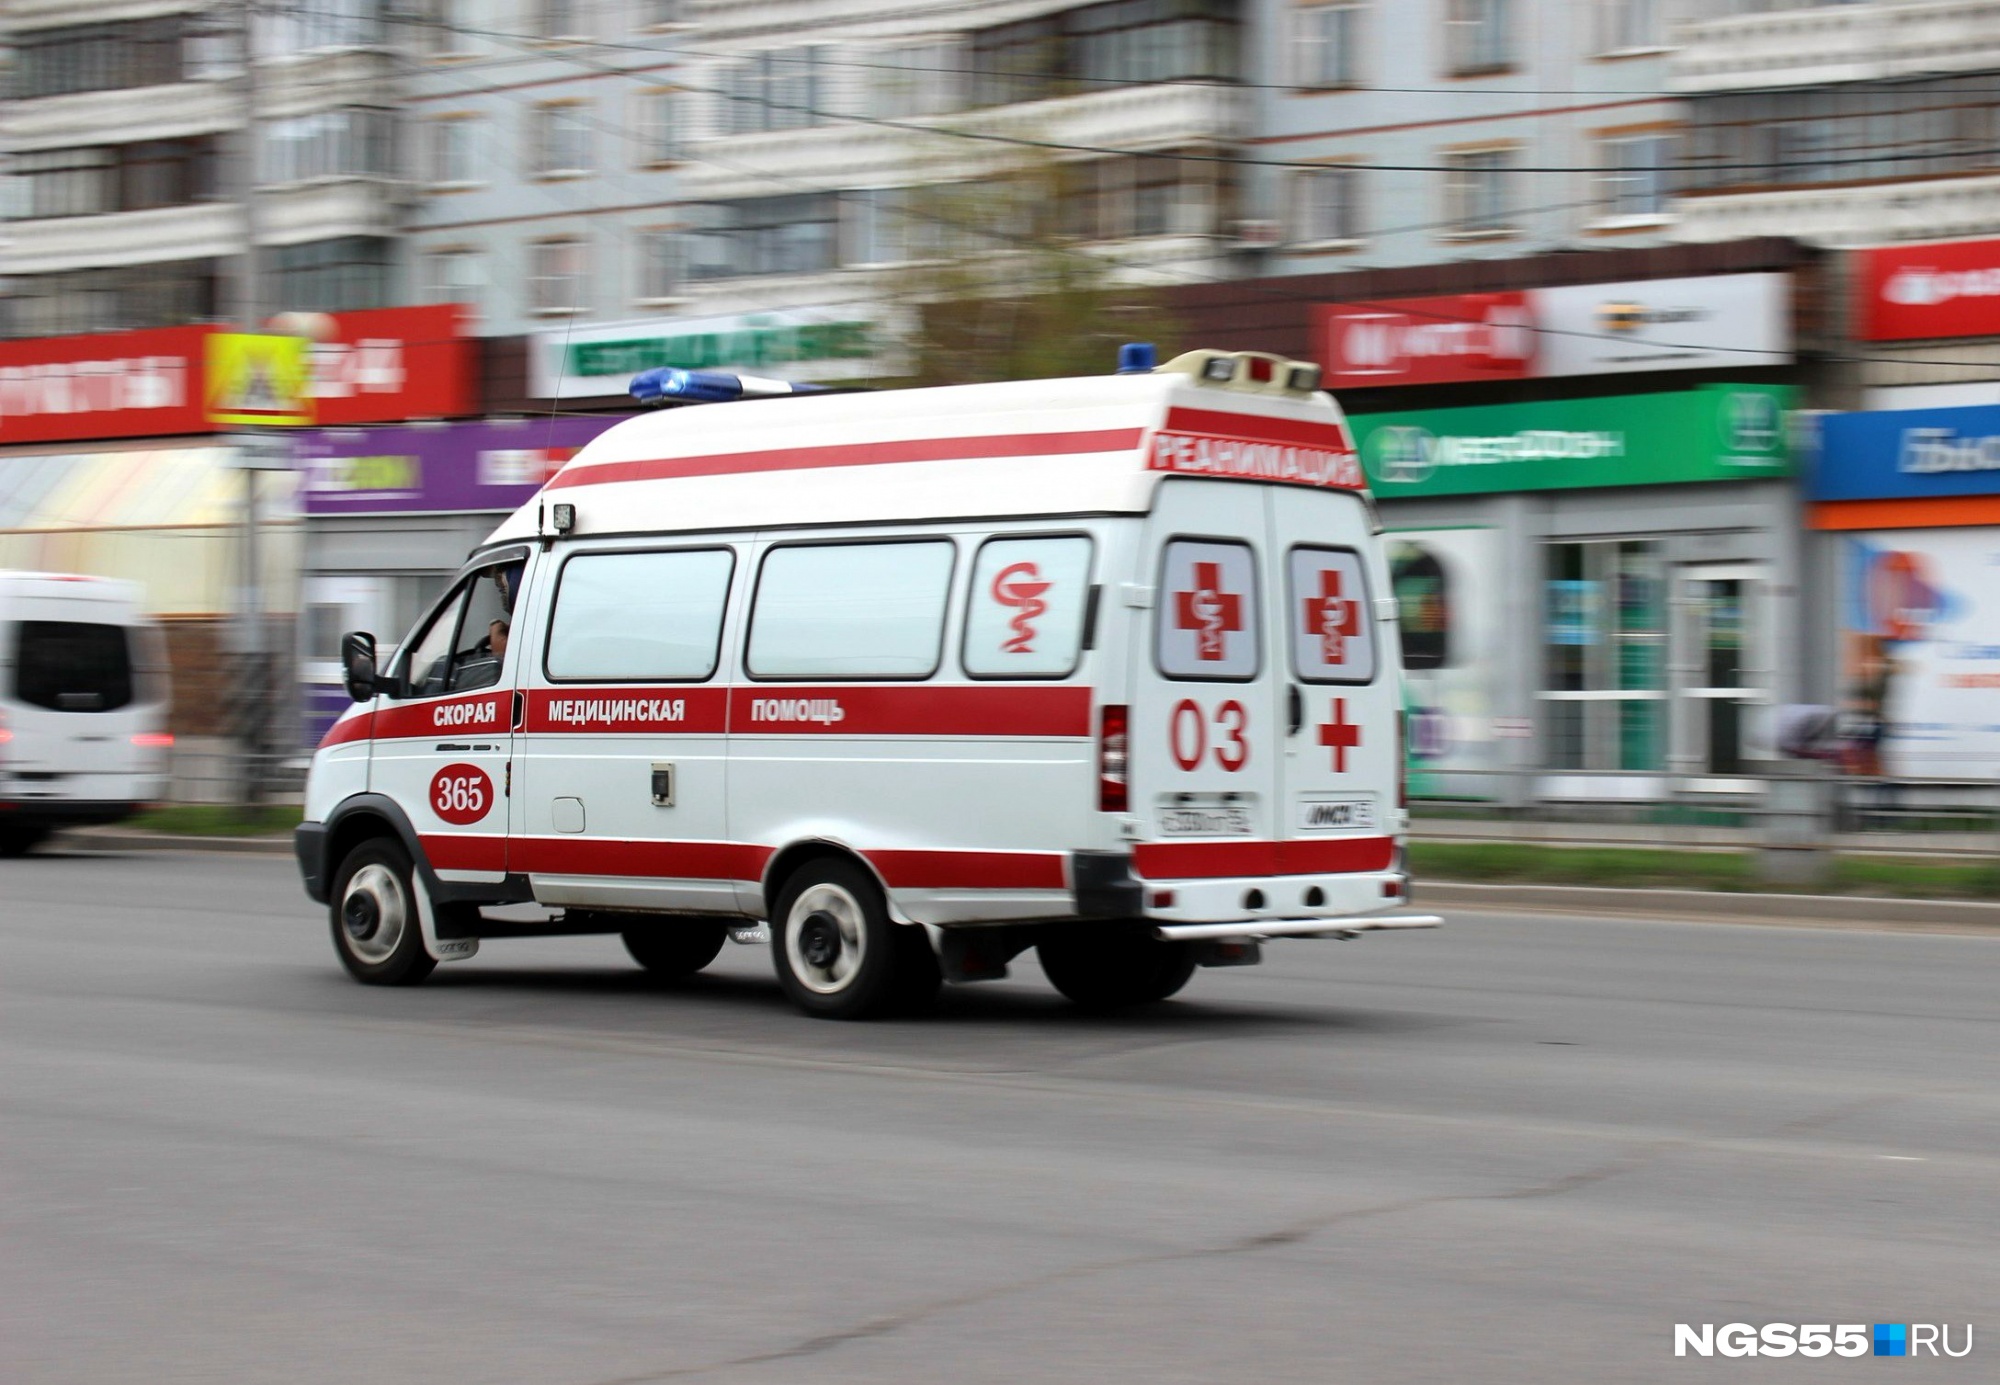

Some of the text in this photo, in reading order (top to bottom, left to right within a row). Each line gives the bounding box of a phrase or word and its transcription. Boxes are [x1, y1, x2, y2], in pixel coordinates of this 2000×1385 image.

[1154, 434, 1363, 486] РЕАНИМАЦИЯ
[433, 698, 845, 726] СКОРАЯ МЕДИЦИНСКАЯ ПОМОЩЬ
[1168, 698, 1252, 773] 03
[437, 776, 484, 812] 365
